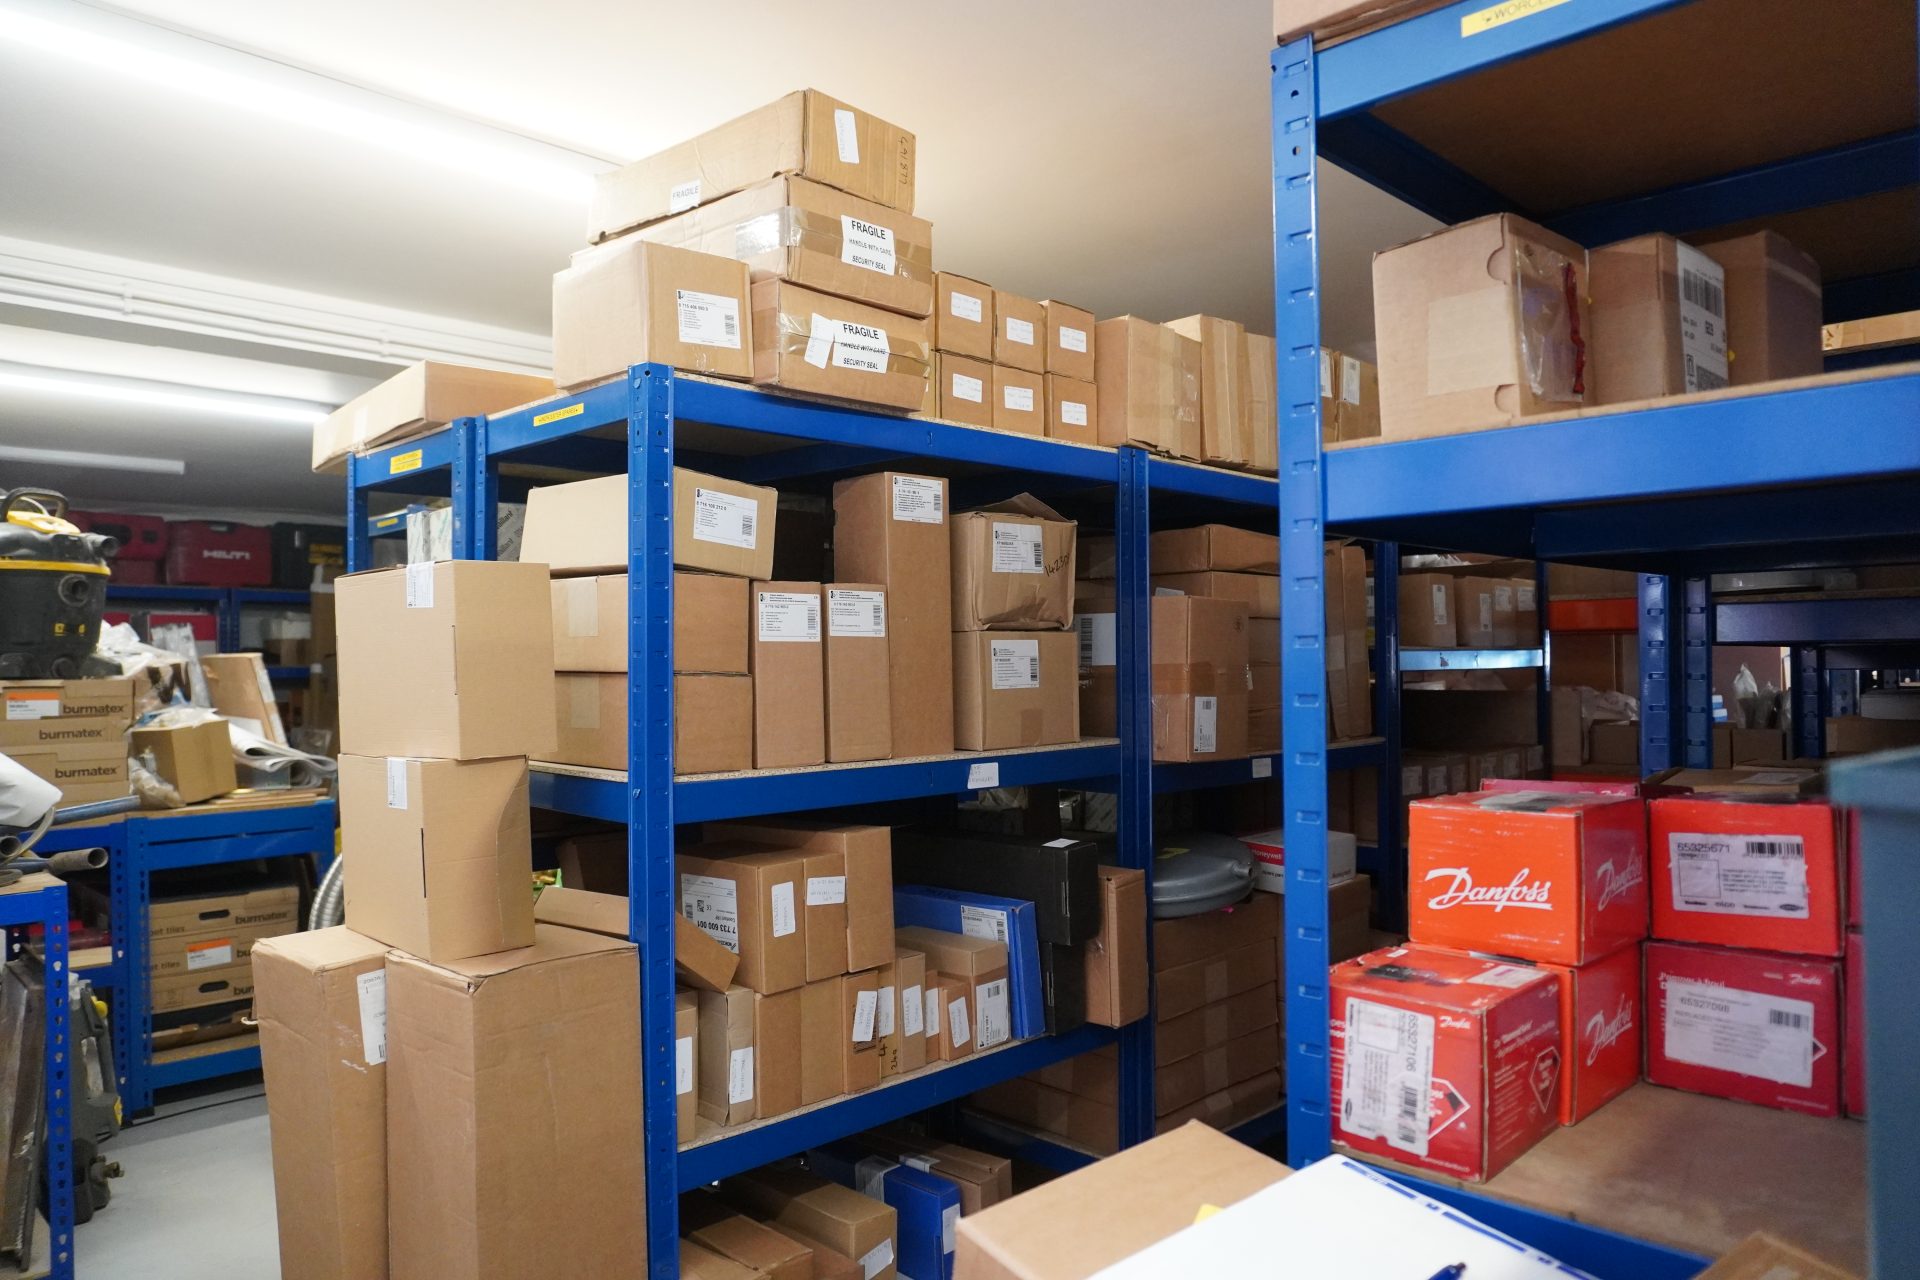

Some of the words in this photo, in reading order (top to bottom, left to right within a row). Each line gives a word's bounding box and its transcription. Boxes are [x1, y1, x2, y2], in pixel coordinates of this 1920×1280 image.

[672, 185, 699, 200] FRAGILE
[851, 220, 886, 240] FRAGILE
[849, 238, 867, 249] HANDLE
[852, 255, 875, 268] SECURITY
[875, 261, 887, 271] SEAL
[843, 323, 880, 340] FRAGILE
[840, 342, 860, 351] HANDLE
[843, 357, 866, 367] SECURITY
[866, 361, 878, 370] SEAL
[63, 704, 124, 715] burmatex
[39, 728, 103, 740] burmatex
[55, 767, 117, 779] burmatex
[1597, 848, 1643, 911] Danfoss
[1424, 867, 1553, 913] Danfoss
[235, 911, 288, 925] burmatex
[697, 920, 707, 929] 001
[708, 922, 719, 931] 600
[720, 924, 731, 932] 733
